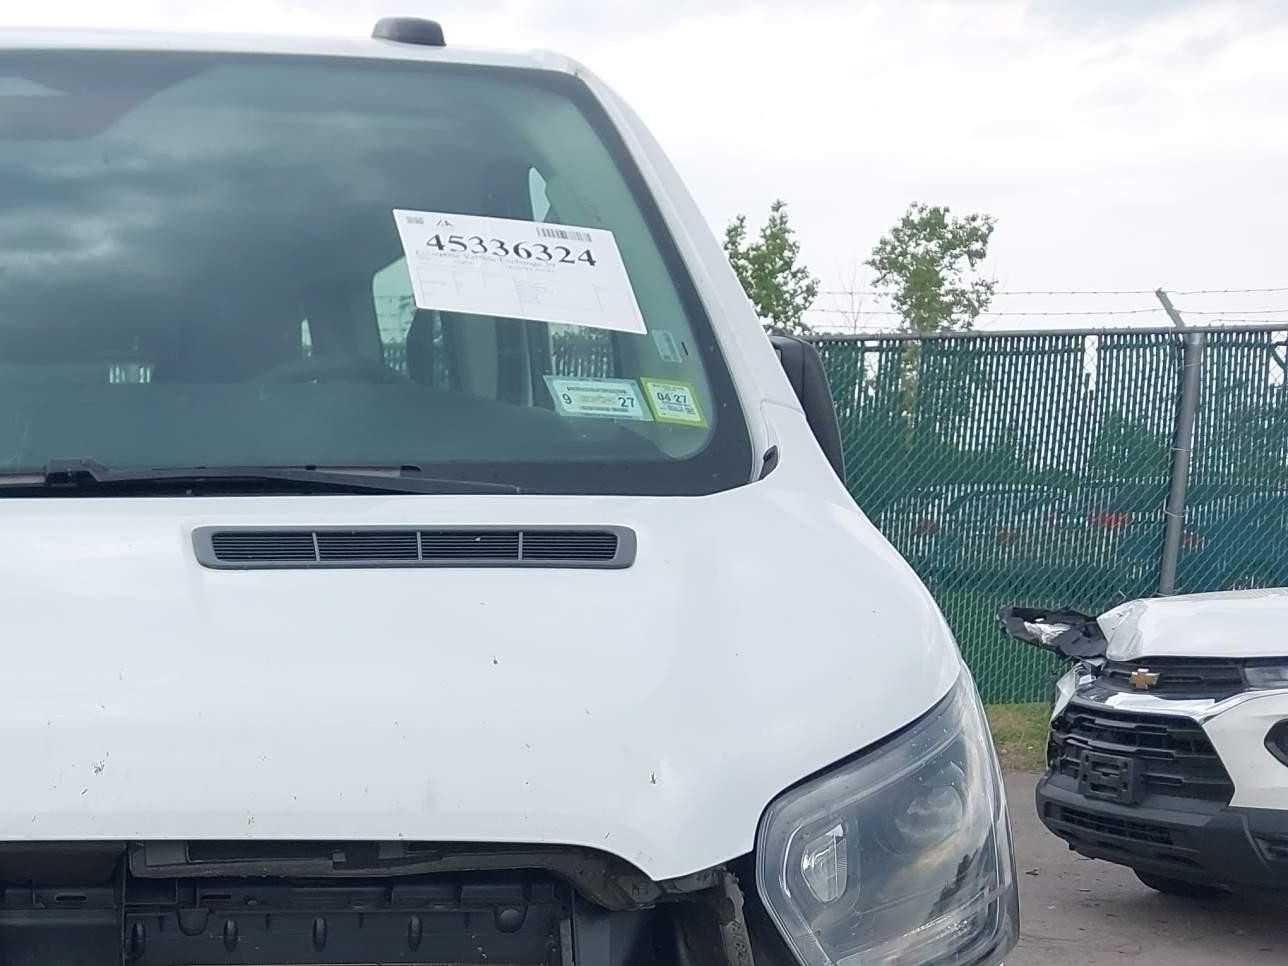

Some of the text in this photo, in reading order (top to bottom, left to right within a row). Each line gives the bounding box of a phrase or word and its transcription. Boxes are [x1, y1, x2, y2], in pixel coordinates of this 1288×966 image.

[425, 233, 598, 267] 45336324
[562, 393, 635, 408] 9 27
[673, 394, 687, 404] 27
